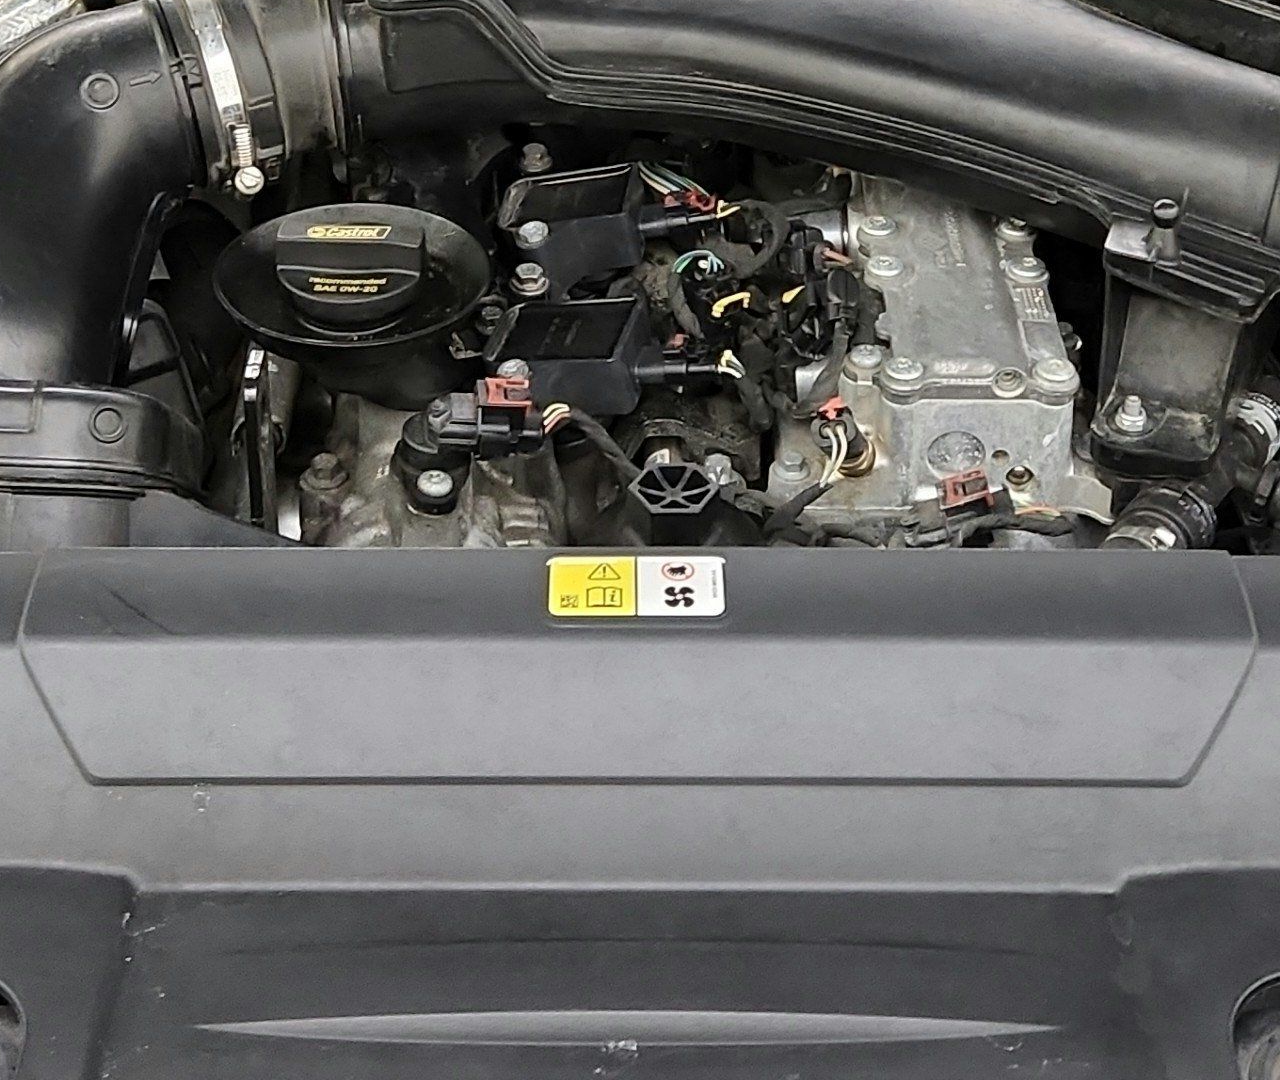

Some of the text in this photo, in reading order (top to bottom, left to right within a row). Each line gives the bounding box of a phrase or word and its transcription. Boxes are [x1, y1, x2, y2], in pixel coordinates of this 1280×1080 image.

[327, 227, 380, 237] Castrol
[308, 277, 387, 285] recommended
[313, 284, 378, 293] SAE 0W-20
